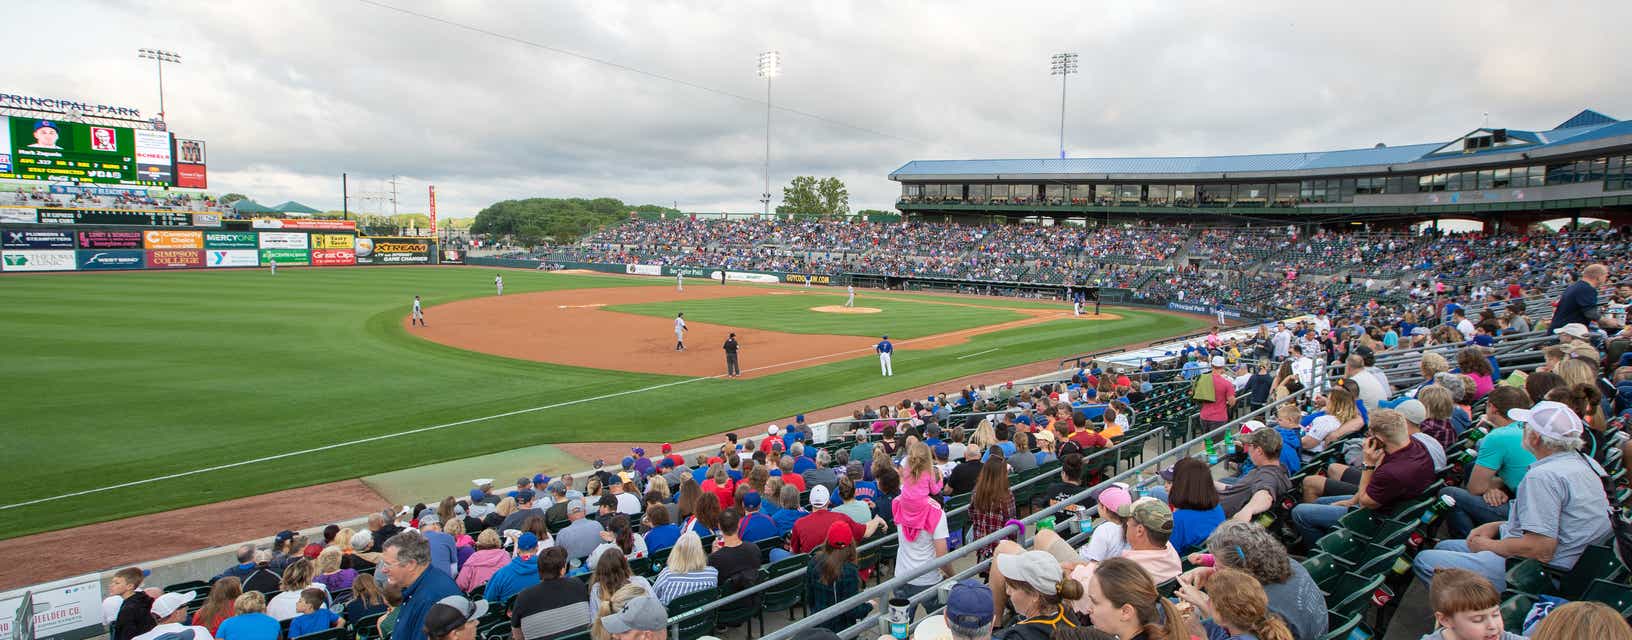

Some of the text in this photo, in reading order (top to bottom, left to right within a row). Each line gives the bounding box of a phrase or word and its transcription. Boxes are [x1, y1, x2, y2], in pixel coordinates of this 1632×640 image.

[0, 93, 141, 117] PRINCIPAL PARK
[336, 251, 354, 259] Clips
